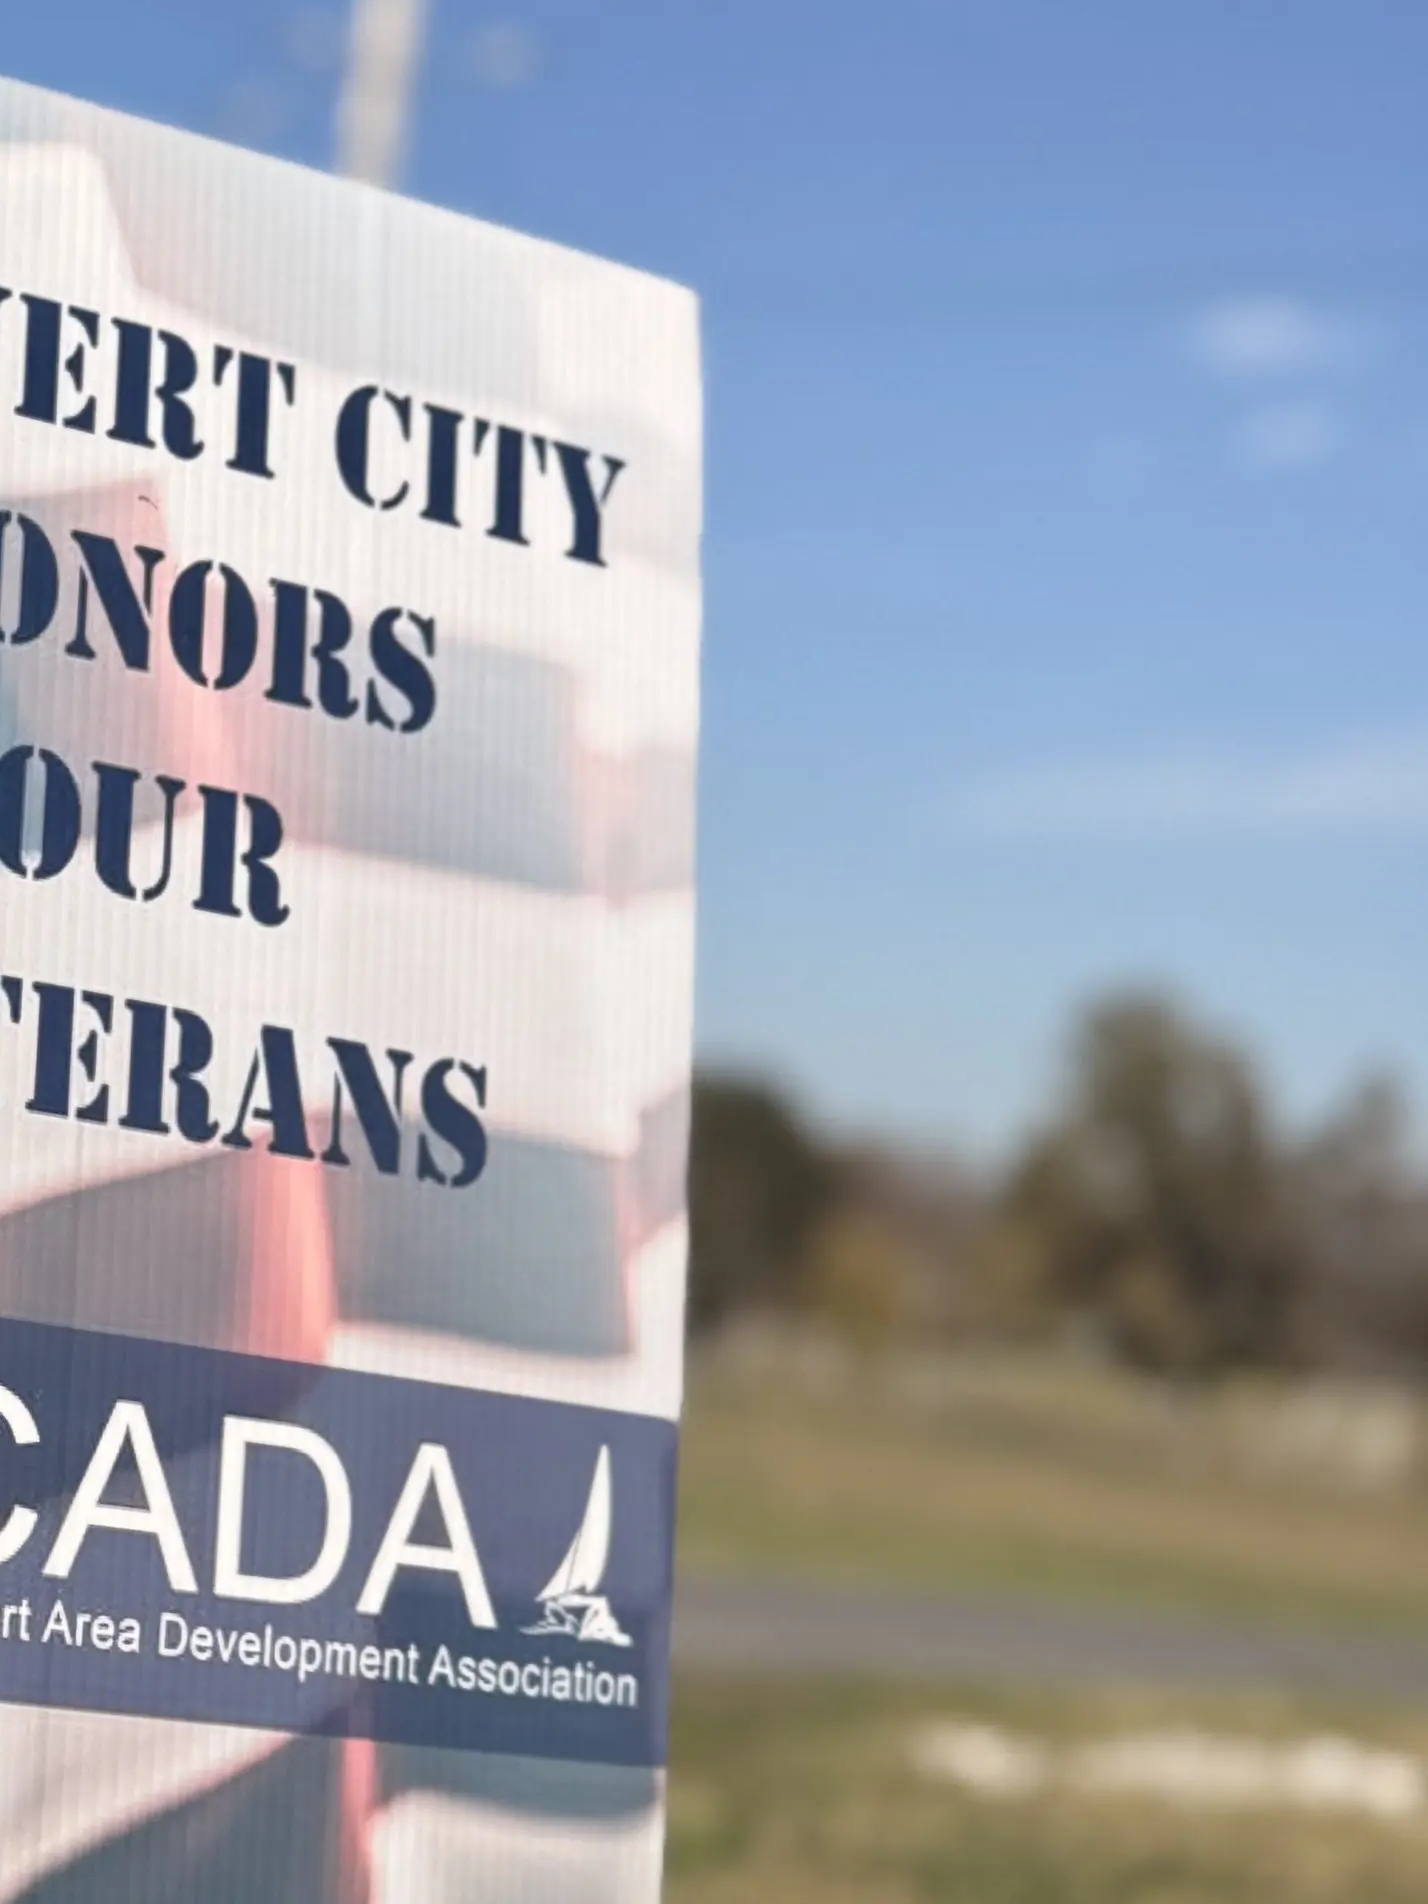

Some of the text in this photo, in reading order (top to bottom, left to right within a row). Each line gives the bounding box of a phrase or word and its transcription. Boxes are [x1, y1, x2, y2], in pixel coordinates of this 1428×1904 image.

[335, 385, 626, 567] CITY
[43, 1600, 141, 1654] Area
[158, 1613, 418, 1685] Development
[429, 1645, 637, 1708] Association
